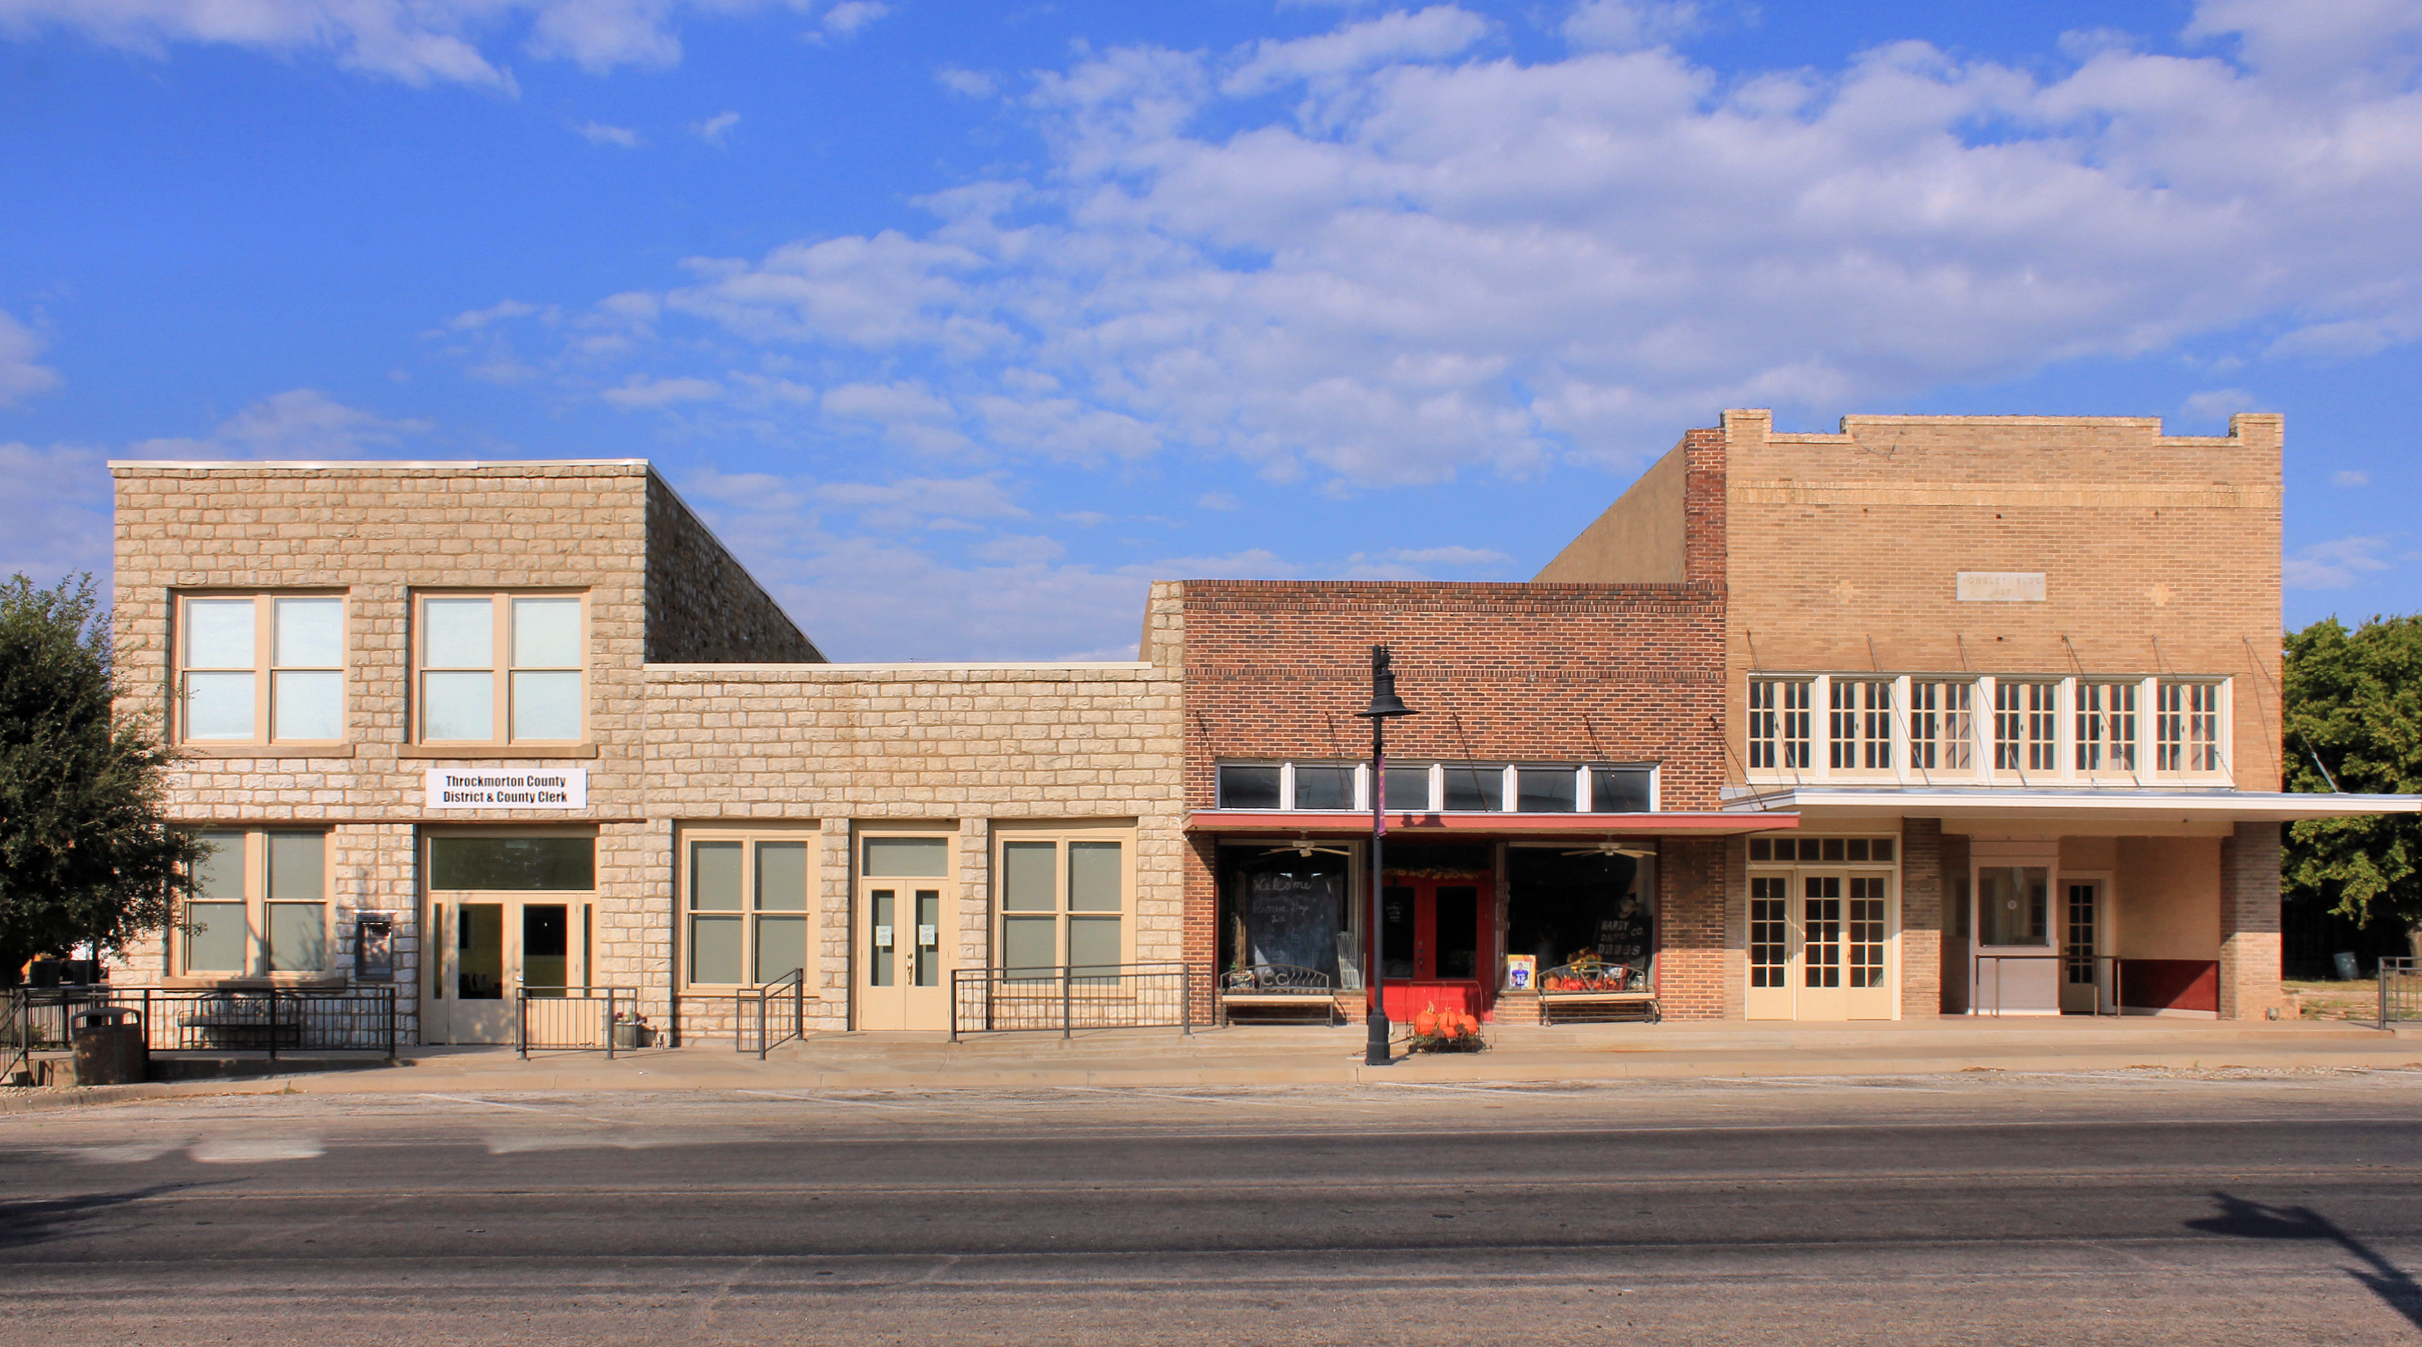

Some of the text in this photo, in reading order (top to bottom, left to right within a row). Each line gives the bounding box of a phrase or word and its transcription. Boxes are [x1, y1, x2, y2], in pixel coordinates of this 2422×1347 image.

[446, 775, 566, 788] Throckmorton County
[443, 791, 568, 804] District & County Clerk
[1253, 877, 1312, 892] Welcome
[1597, 943, 1641, 956] DRUGS
